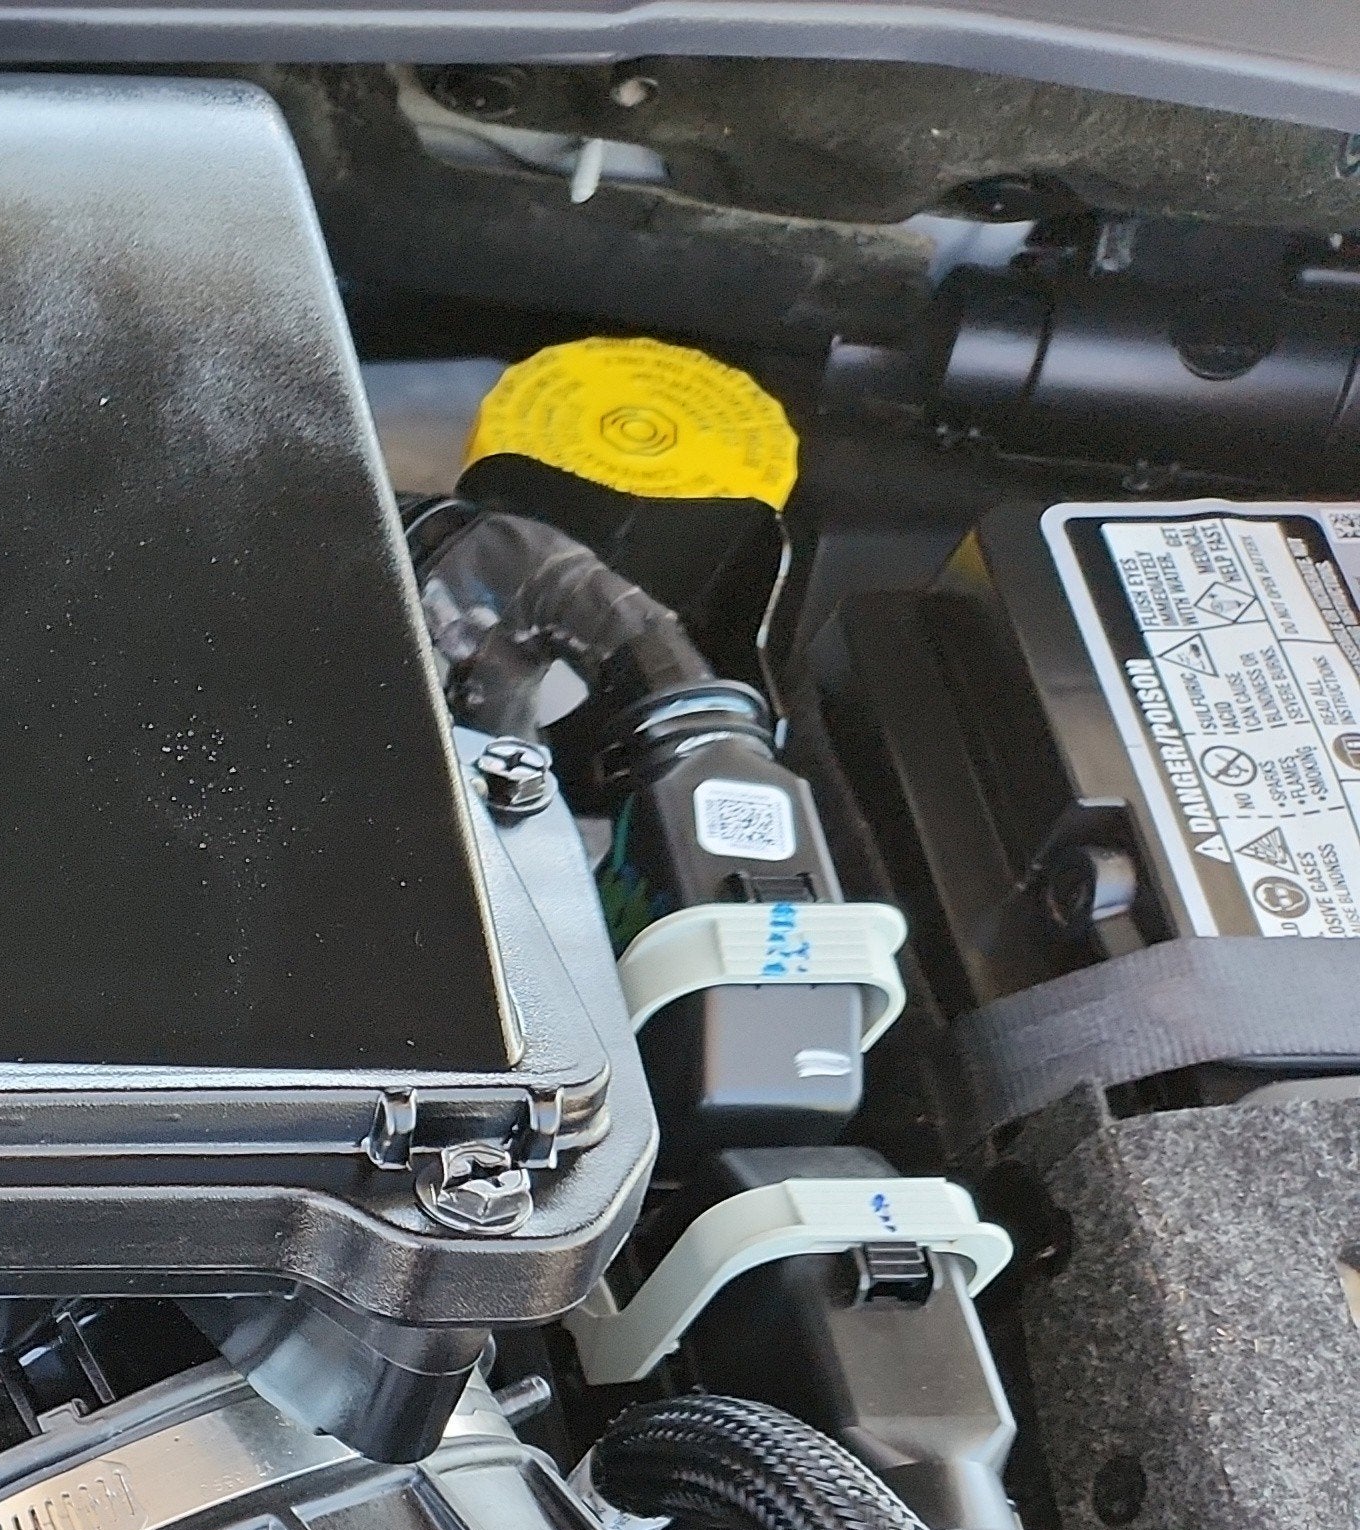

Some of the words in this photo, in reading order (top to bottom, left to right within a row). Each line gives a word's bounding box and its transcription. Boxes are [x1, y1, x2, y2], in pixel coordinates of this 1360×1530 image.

[1160, 526, 1182, 546] GET
[1178, 525, 1214, 574] MEDICAL
[1118, 558, 1145, 586] EYES
[1215, 554, 1241, 581] HELP
[1132, 591, 1161, 626] FLUSH
[1173, 597, 1198, 624] WITH
[1180, 672, 1218, 729] SULFURIC
[1224, 671, 1251, 704] CAUSE
[1275, 682, 1304, 718] SEVERE
[1305, 679, 1325, 696] ALL
[1213, 701, 1239, 728] ACID
[1239, 705, 1261, 726] CAN
[1314, 698, 1338, 725] READ
[1125, 659, 1217, 834] DANGER/POISON
[1233, 792, 1254, 809] NO
[1297, 852, 1328, 892] GASES
[1316, 897, 1347, 937] OSIVE
